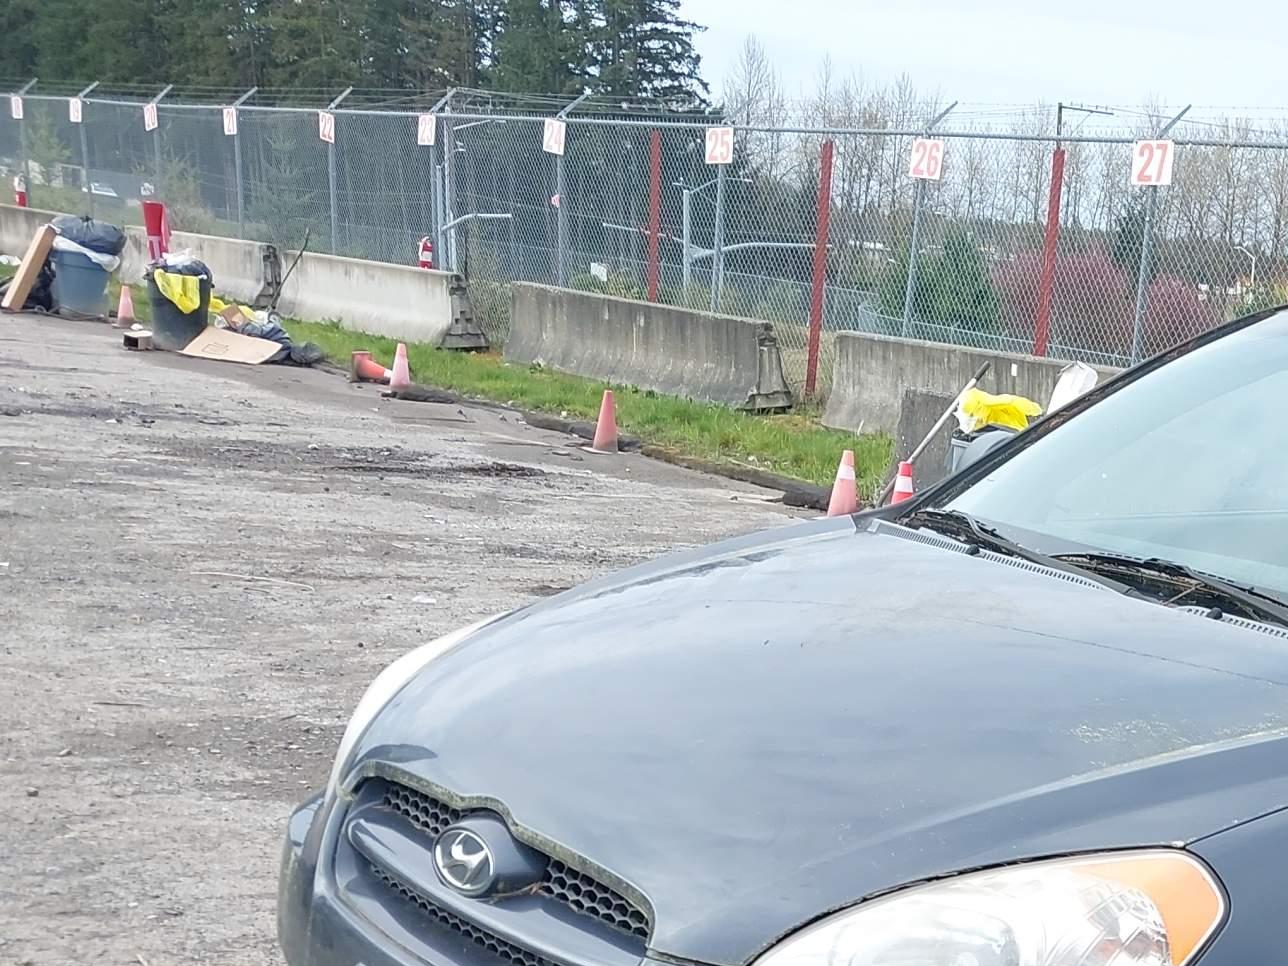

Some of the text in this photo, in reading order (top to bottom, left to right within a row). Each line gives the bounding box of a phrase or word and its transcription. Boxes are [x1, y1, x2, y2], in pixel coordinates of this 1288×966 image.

[226, 109, 236, 132] 21
[321, 113, 334, 141] 22
[420, 116, 434, 143] 23
[708, 130, 731, 161] 25
[913, 142, 939, 176] 26
[1136, 143, 1168, 183] 27
